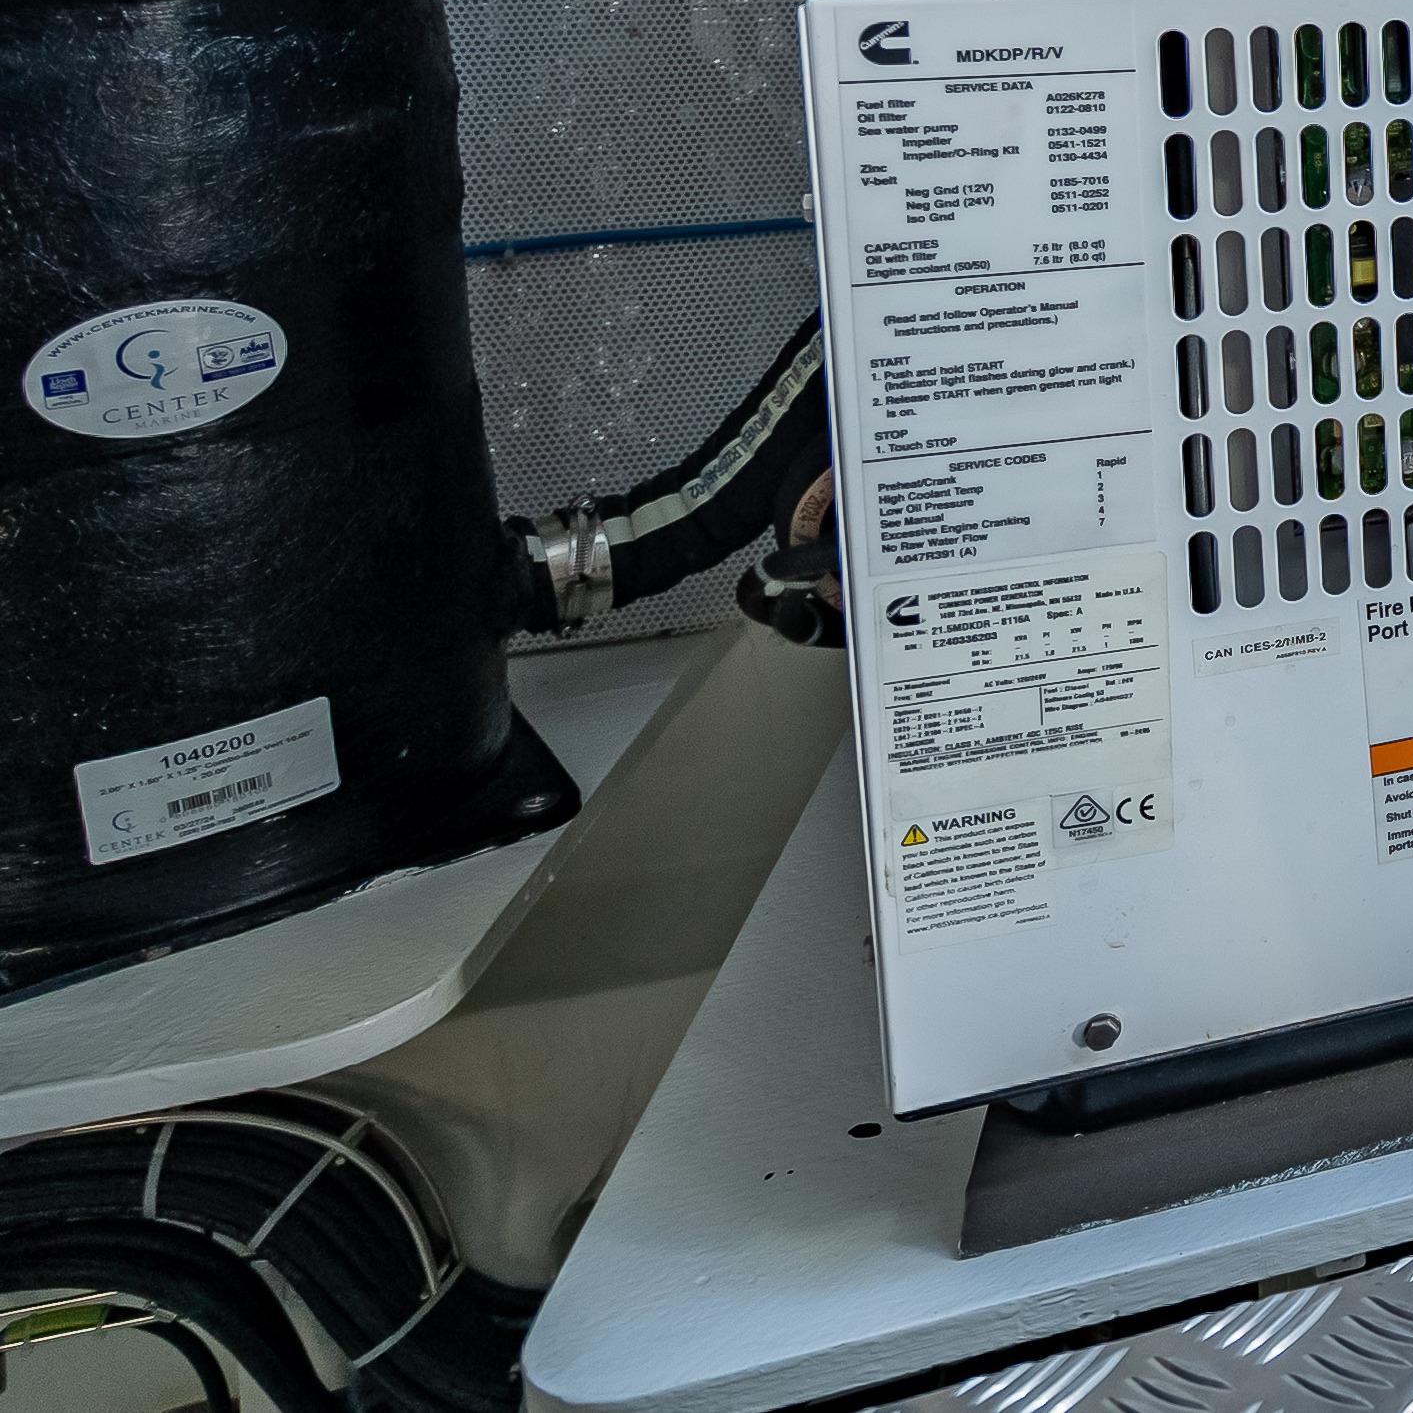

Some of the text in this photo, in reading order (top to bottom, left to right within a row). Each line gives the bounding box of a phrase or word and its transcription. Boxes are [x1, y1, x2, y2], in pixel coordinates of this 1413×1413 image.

[860, 20, 905, 50] Cummins
[956, 46, 1063, 62] MDKDP/R/V
[944, 80, 1033, 93] SERVICE DATA
[1045, 91, 1105, 101] A026K278
[856, 99, 916, 109] Fuel filter
[1046, 103, 1105, 114] 0122-0810
[856, 112, 907, 123] Oil filter
[857, 124, 958, 136] Sea water pump
[901, 136, 952, 147] Impeller
[1047, 138, 1106, 149] 0541-1521
[902, 145, 1019, 161] Impeller/O-Ring Kit
[859, 164, 887, 173] Zinc
[860, 176, 897, 186] V-belt
[1049, 175, 1109, 187] 0185-7016
[904, 182, 994, 198] Neg Gnd (12V)
[905, 196, 994, 211] Neg Gnd (24V)
[1051, 201, 1108, 213] 0511-0201
[906, 211, 954, 223] Iso Gnd
[863, 239, 939, 253] CAPACITIES
[1032, 239, 1105, 252] 7.6 ltr (8.0 qt)
[865, 252, 937, 265] Oil with filter
[866, 267, 906, 279] Engine
[908, 263, 951, 274] coolant
[954, 281, 1025, 295] OPERATION
[48, 305, 257, 358] WWW.CENTEKMARINE.COM
[102, 387, 230, 424] CENTEK
[948, 453, 1046, 472] SERVICE CODES
[1096, 456, 1126, 467] Rapid
[878, 486, 983, 505] High Coolant Temp
[879, 499, 974, 516] Low Oil Pressure
[879, 513, 944, 528] See Manual
[880, 516, 1030, 541] Excessive Engine Cranking
[881, 533, 988, 553] No Raw Water Flow
[959, 546, 976, 558] (A)
[1046, 609, 1073, 620] Spec:
[1076, 607, 1083, 616] A
[1365, 601, 1403, 620] Fire
[1367, 620, 1409, 642] Port
[1204, 647, 1232, 660] CAN
[159, 732, 255, 768] 1040200
[1382, 777, 1394, 786] In
[1116, 793, 1155, 825] CE
[1385, 809, 1411, 822] Shut
[931, 808, 1016, 831] WARNING
[99, 830, 166, 853] CENTEK
